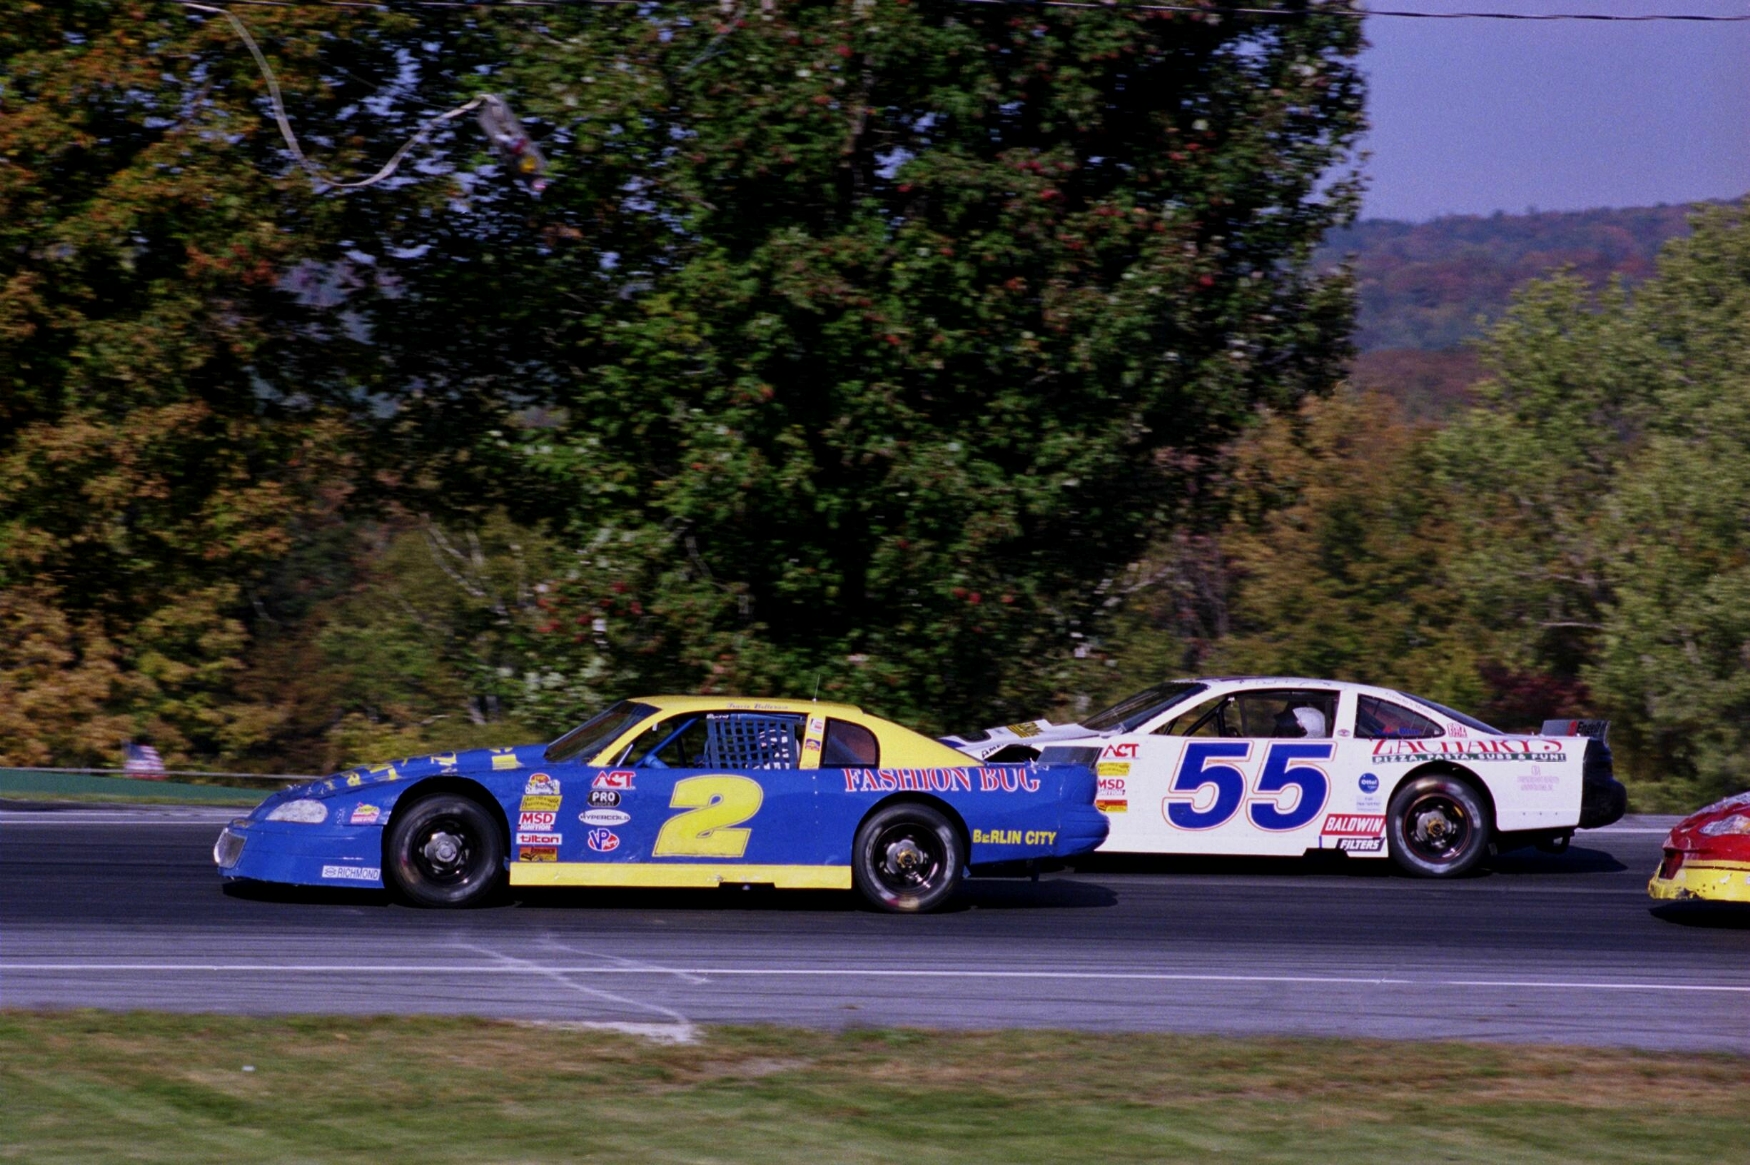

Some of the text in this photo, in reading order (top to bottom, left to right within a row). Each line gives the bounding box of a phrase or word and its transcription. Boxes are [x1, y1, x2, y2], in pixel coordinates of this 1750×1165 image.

[1102, 743, 1140, 758] ACT
[1478, 753, 1512, 761] SUBS
[1531, 753, 1565, 761] FUN!
[592, 771, 636, 788] ACT
[843, 767, 1041, 793] FASHION BUG
[1098, 779, 1125, 790] MSD
[1162, 740, 1337, 833] 55
[592, 792, 616, 802] PRO
[521, 813, 553, 824] MSD
[652, 773, 764, 858] 2
[1325, 816, 1384, 832] BALDWIN
[520, 834, 560, 844] tilton
[589, 829, 611, 851] VP
[1025, 831, 1057, 845] CITY
[1339, 839, 1381, 850] FILTERS
[337, 867, 380, 880] RICHMOND
